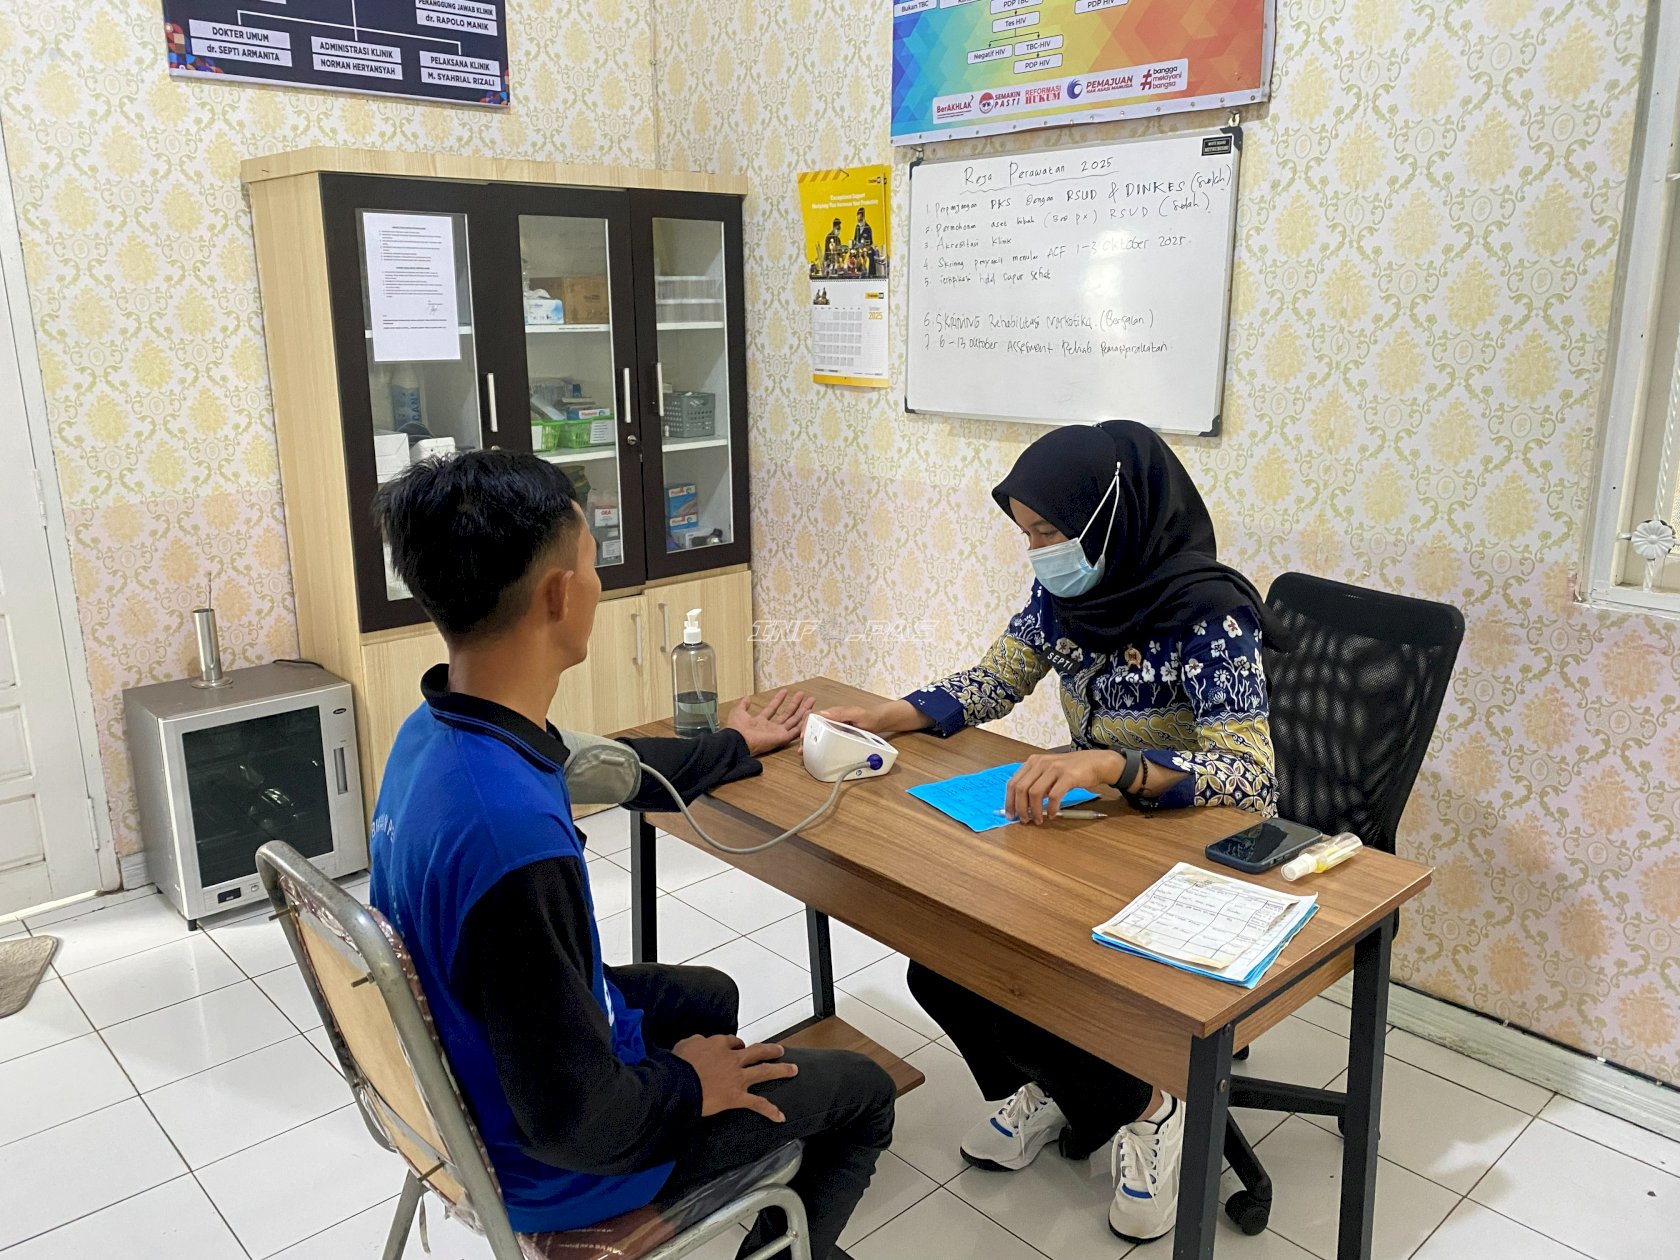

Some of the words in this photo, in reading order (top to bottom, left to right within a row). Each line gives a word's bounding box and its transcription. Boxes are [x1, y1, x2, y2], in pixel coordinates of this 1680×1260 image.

[418, 0, 456, 10] PENANGGUNG
[457, 5, 476, 13] JAWAB
[476, 7, 493, 16] KLINIK
[901, 4, 918, 12] Bukan
[918, 0, 929, 8] TBC
[1003, 0, 1016, 8] PDP
[1088, 0, 1102, 8] PDP
[425, 14, 434, 22] dr.
[436, 16, 465, 26] RAPOLO
[466, 21, 489, 30] MANIK
[212, 26, 244, 39] DOKTER
[246, 32, 270, 42] UMUM
[320, 42, 370, 56] ADMINISTRASI
[371, 48, 394, 58] KLINIK
[1026, 40, 1051, 50] TBC-HIV
[206, 44, 217, 53] dr.
[218, 46, 240, 56] SEPTI
[242, 49, 280, 61] ARMANITA
[973, 50, 994, 60] Negatif
[996, 48, 1006, 56] HIV
[320, 58, 351, 70] NORMAN
[352, 62, 396, 75] HERYANSYAH
[430, 56, 470, 68] PELAKSANA
[470, 61, 490, 71] KLINIK
[1024, 61, 1038, 69] PDP
[428, 72, 436, 80] M.
[437, 73, 472, 84] SYAHRIAL
[472, 78, 495, 86] RIZALI
[1086, 76, 1134, 89] PEMAJUAN
[1152, 71, 1182, 82] melayani
[1025, 85, 1062, 96] REFORMASI
[1152, 80, 1176, 89] bangsa
[994, 91, 1021, 100] SEMAKIN
[1025, 92, 1061, 104] HUKUM
[936, 101, 972, 114] BerAKHLAK
[994, 98, 1020, 108] PASTI
[1008, 160, 1066, 186] Perawatan
[1080, 156, 1114, 172] 2025
[990, 197, 1012, 210] PKS
[1066, 189, 1098, 202] RSUD
[1125, 180, 1186, 198] DINKES
[1110, 206, 1150, 220] RSUD
[1047, 652, 1074, 670] SEPTI
